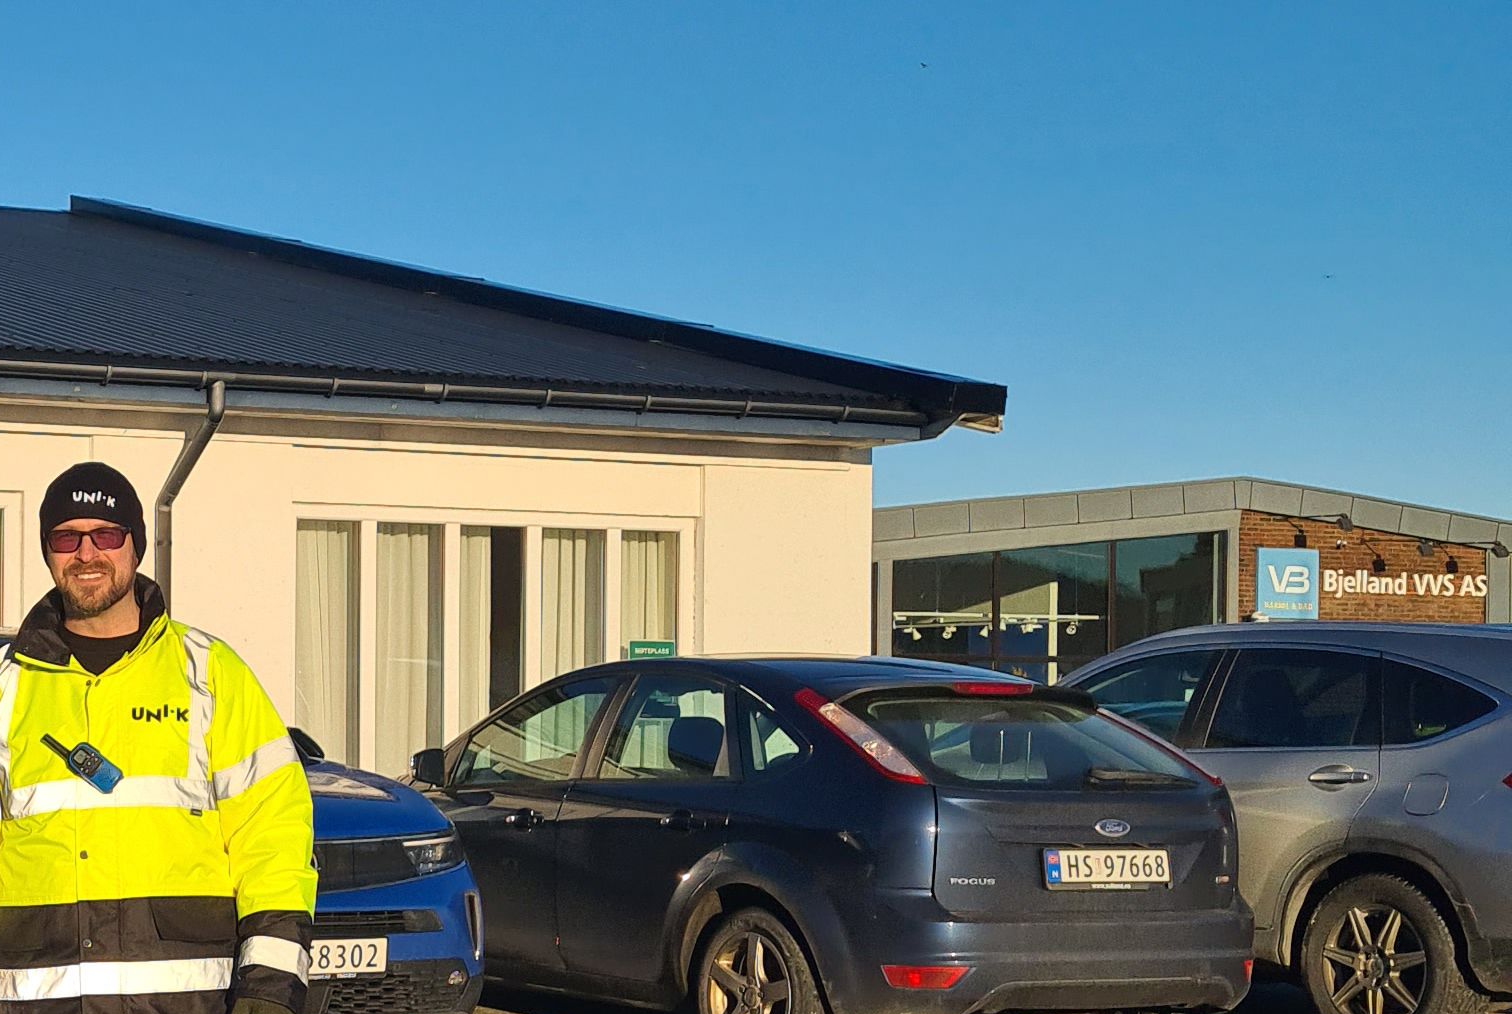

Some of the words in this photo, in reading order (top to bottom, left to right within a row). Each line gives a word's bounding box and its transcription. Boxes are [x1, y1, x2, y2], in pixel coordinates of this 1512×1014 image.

[1268, 565, 1310, 594] VB
[1323, 569, 1407, 598] Bjelland
[1412, 573, 1455, 596] VVS
[1459, 574, 1488, 597] AS
[1051, 870, 1059, 878] N
[1067, 854, 1093, 878] HS
[1104, 854, 1165, 878] 97668
[950, 877, 996, 886] FOCUS
